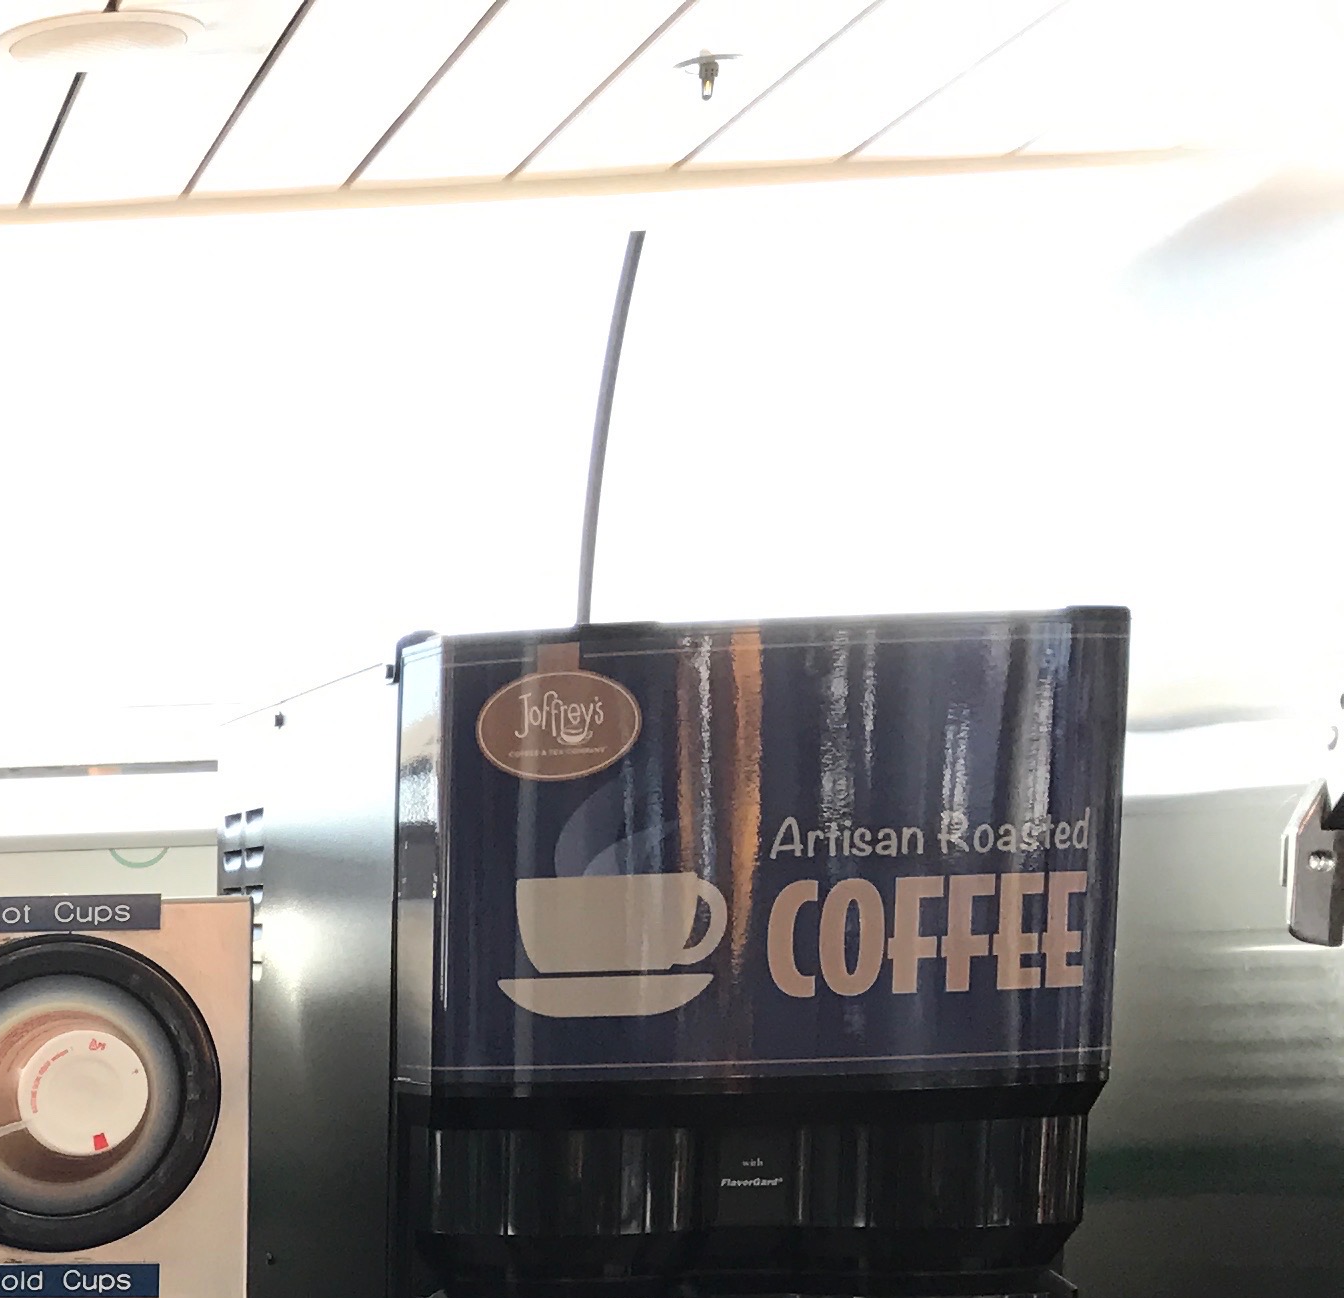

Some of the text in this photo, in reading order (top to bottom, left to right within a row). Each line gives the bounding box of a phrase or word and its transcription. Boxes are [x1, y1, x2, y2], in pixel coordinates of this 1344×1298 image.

[514, 690, 605, 742] Joffrey's
[769, 806, 1091, 860] Artisan Roasted
[54, 901, 132, 925] Cups
[767, 870, 1088, 998] COFFEE
[62, 1269, 132, 1293] Cups
